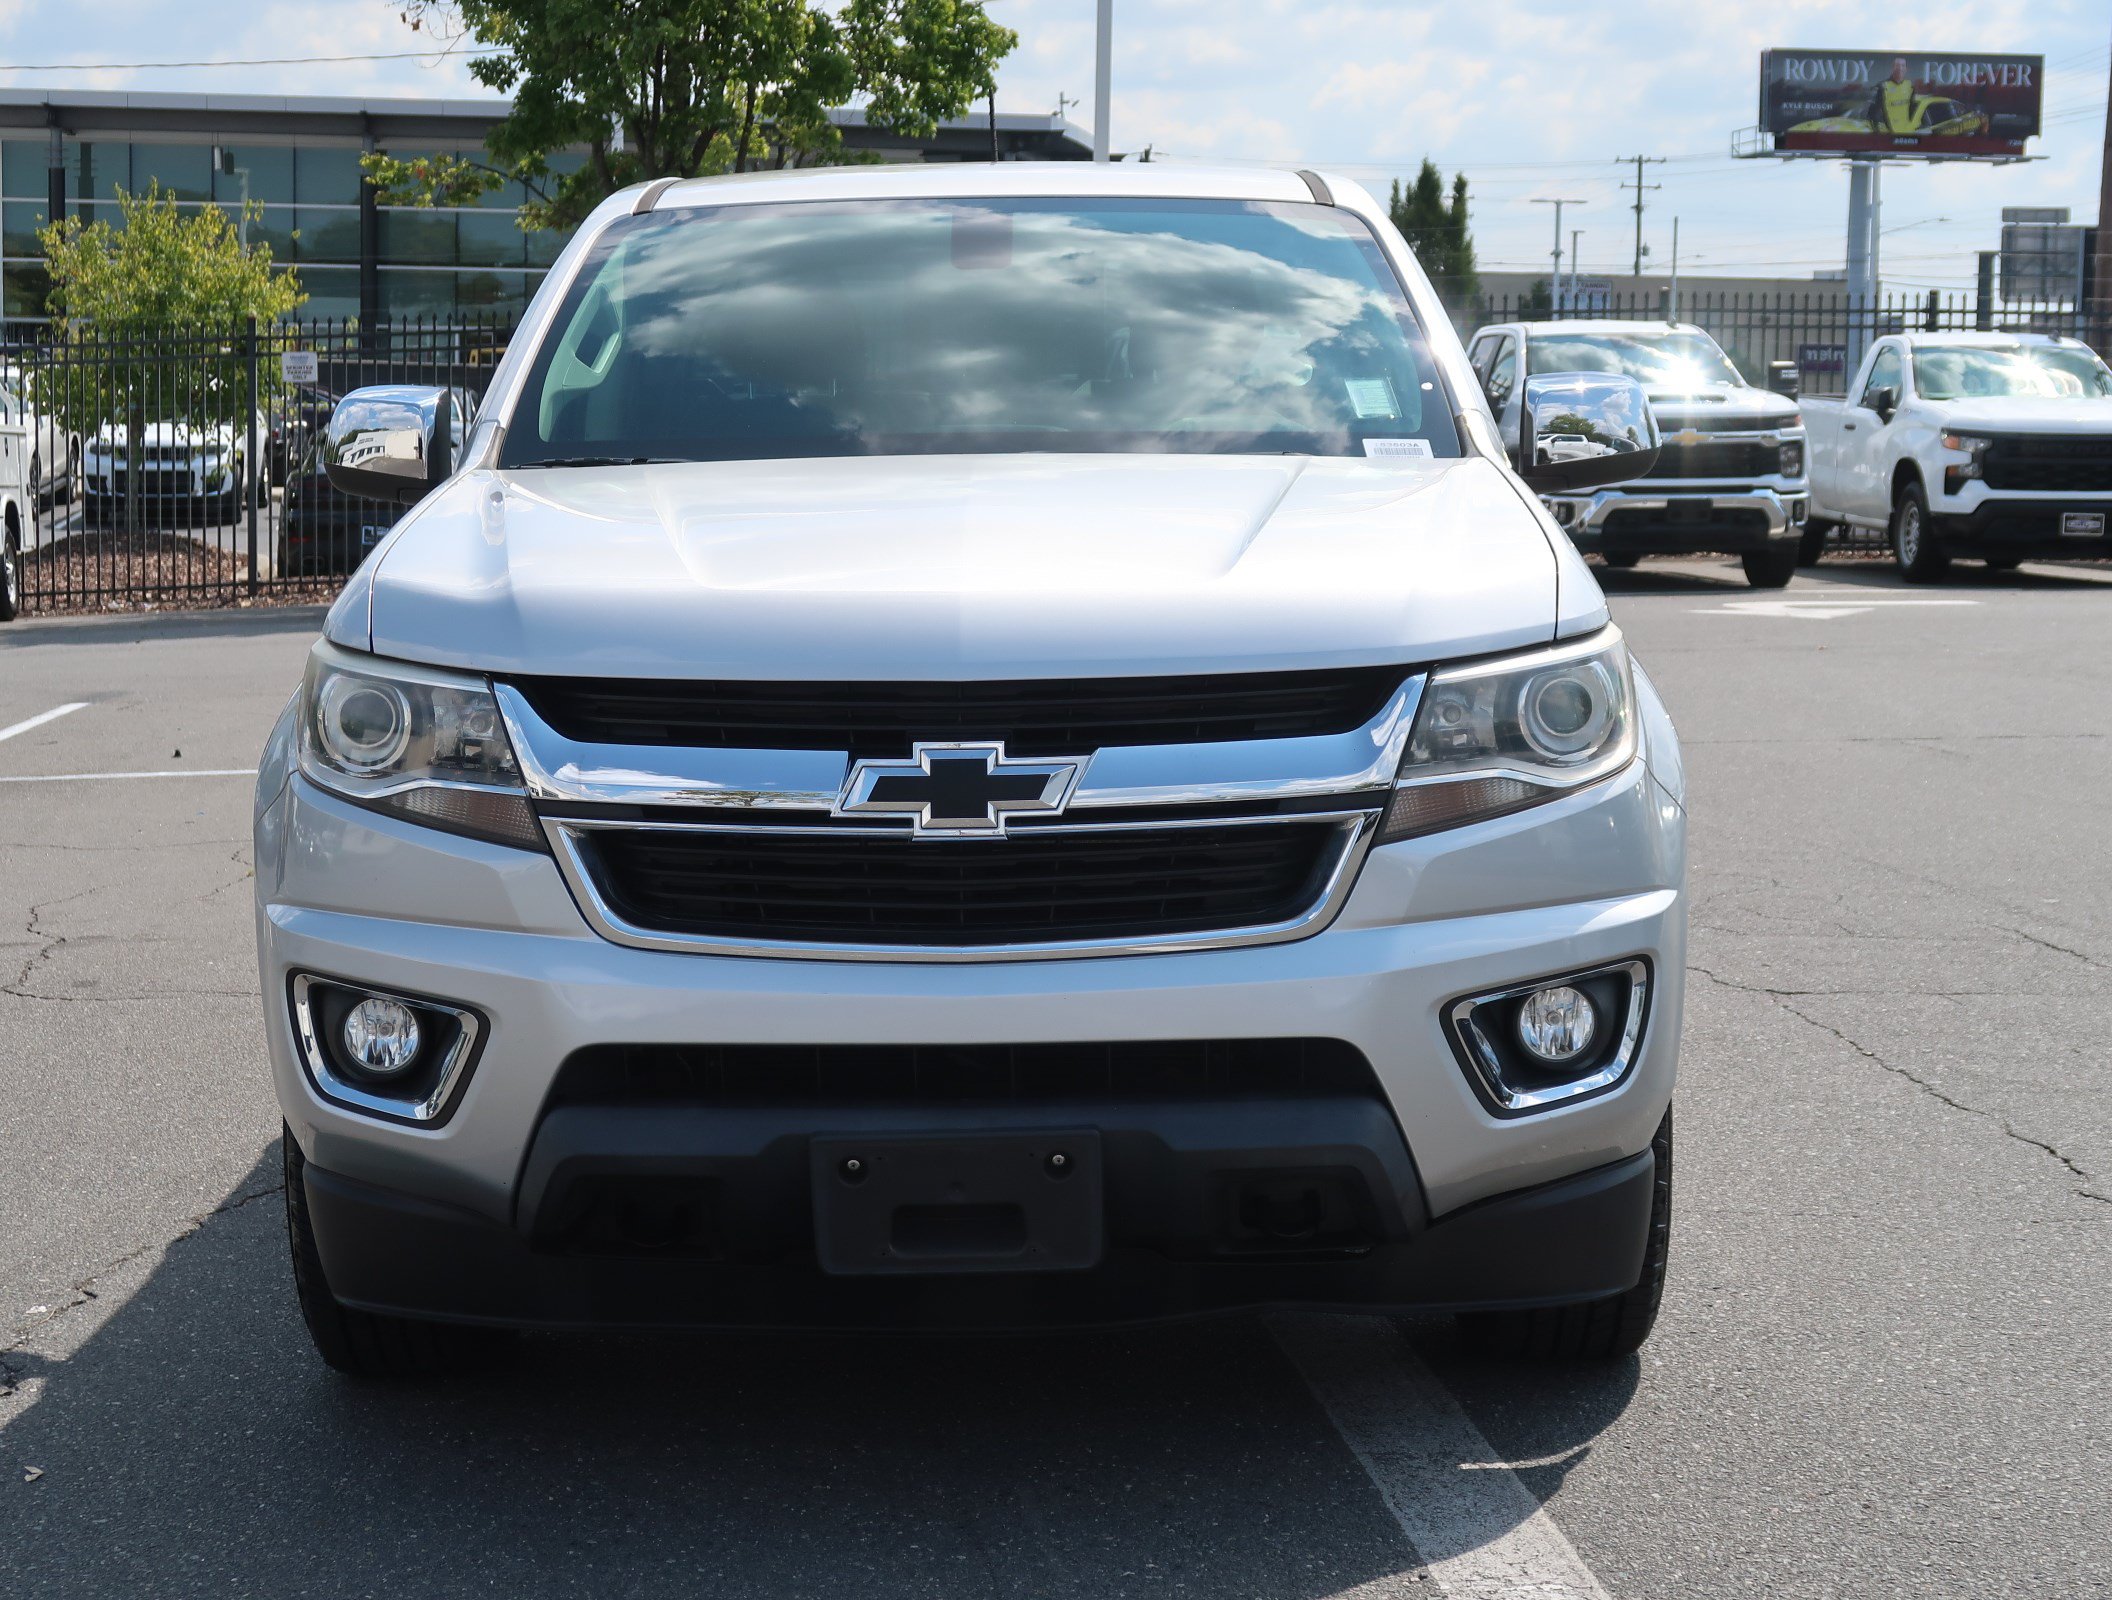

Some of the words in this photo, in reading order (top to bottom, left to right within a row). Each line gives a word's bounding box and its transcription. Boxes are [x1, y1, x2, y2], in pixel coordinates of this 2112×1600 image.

[1784, 58, 1874, 82] ROWDY
[1922, 61, 2032, 87] FOREVER
[1805, 102, 1833, 110] BUSCH
